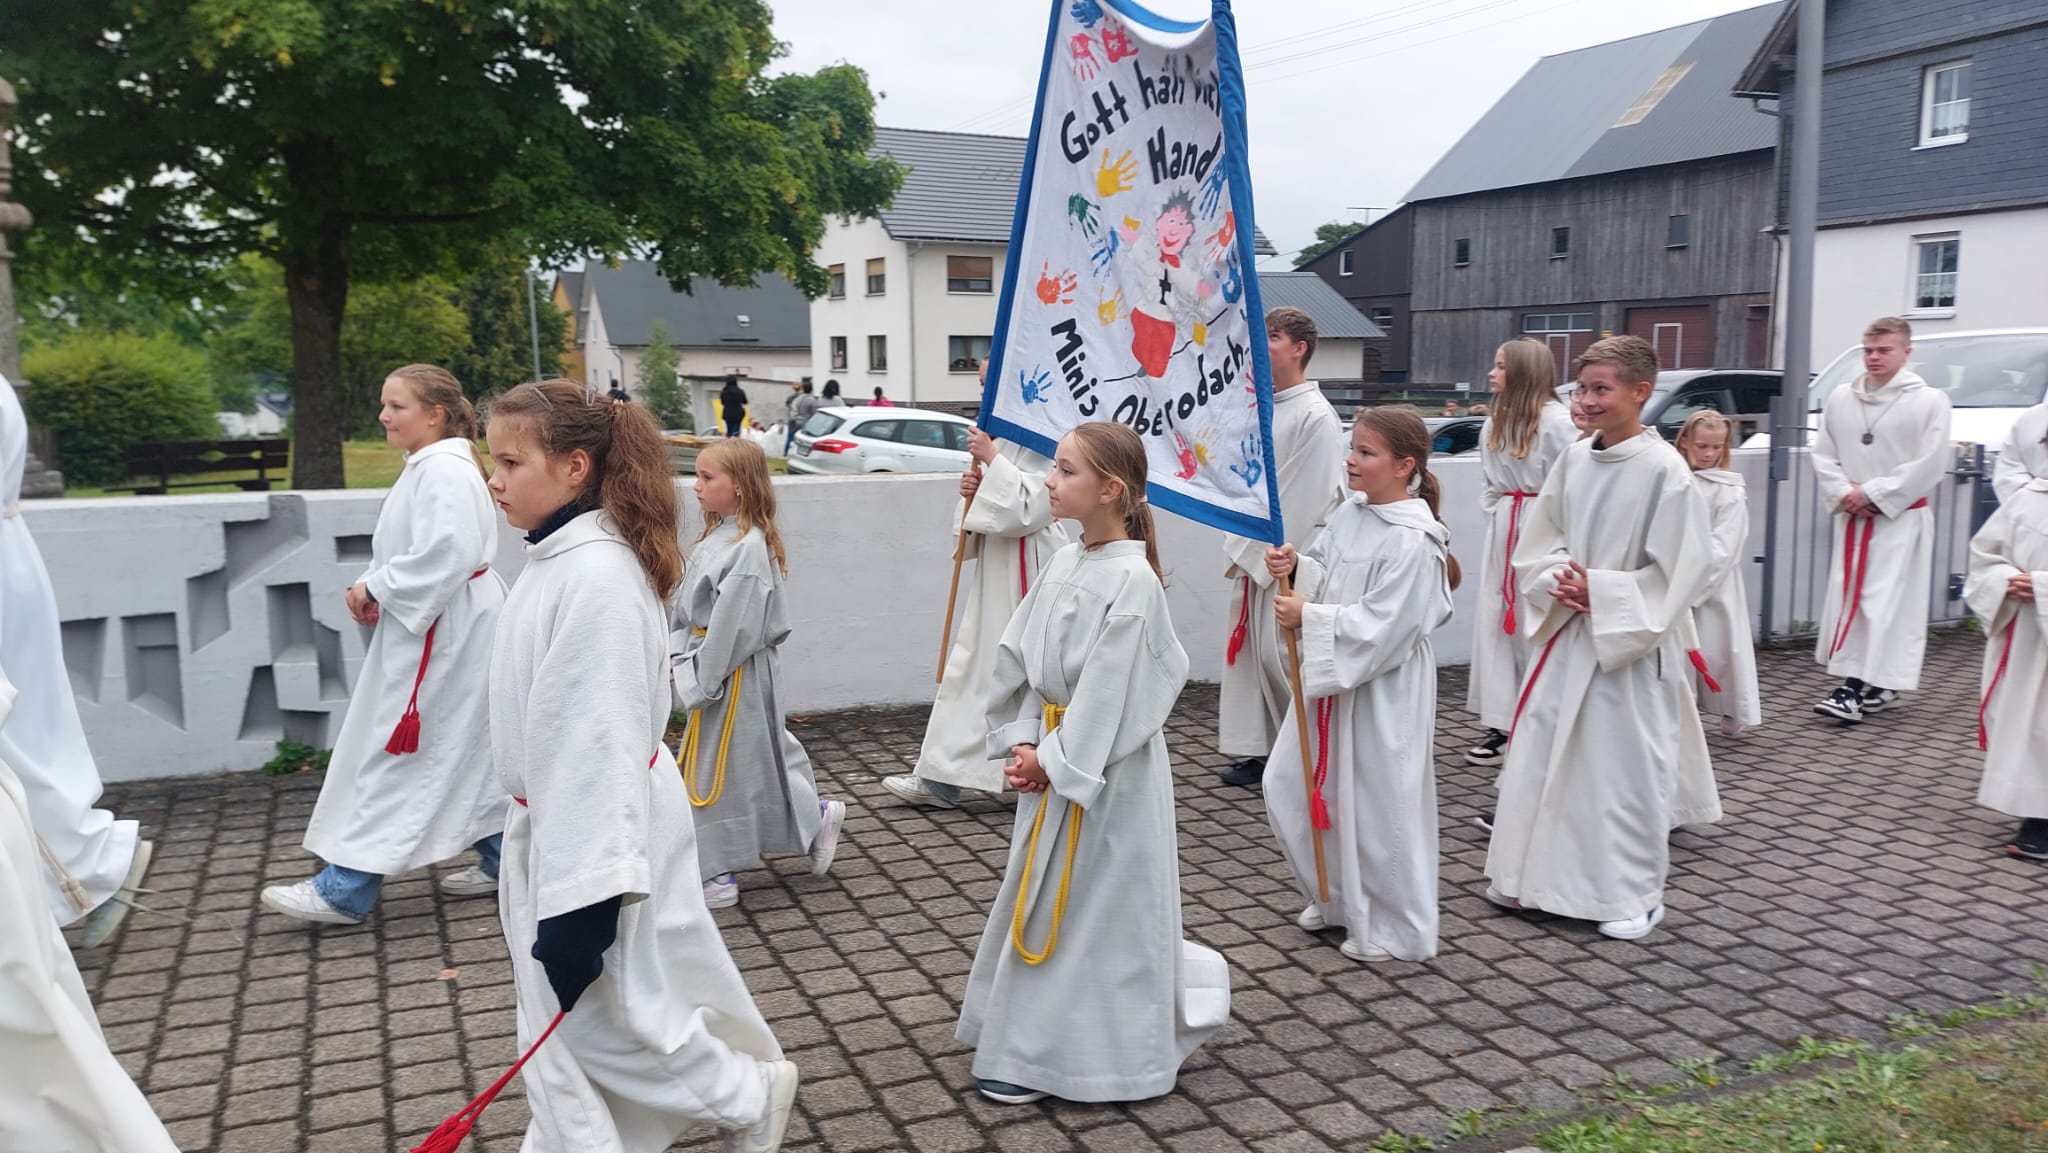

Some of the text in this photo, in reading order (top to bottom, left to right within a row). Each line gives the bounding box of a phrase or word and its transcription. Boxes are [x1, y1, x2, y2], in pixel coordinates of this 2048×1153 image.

[1060, 80, 1130, 164] Gott
[1146, 125, 1222, 185] Hand
[1050, 317, 1245, 437] Minis Oberodach
